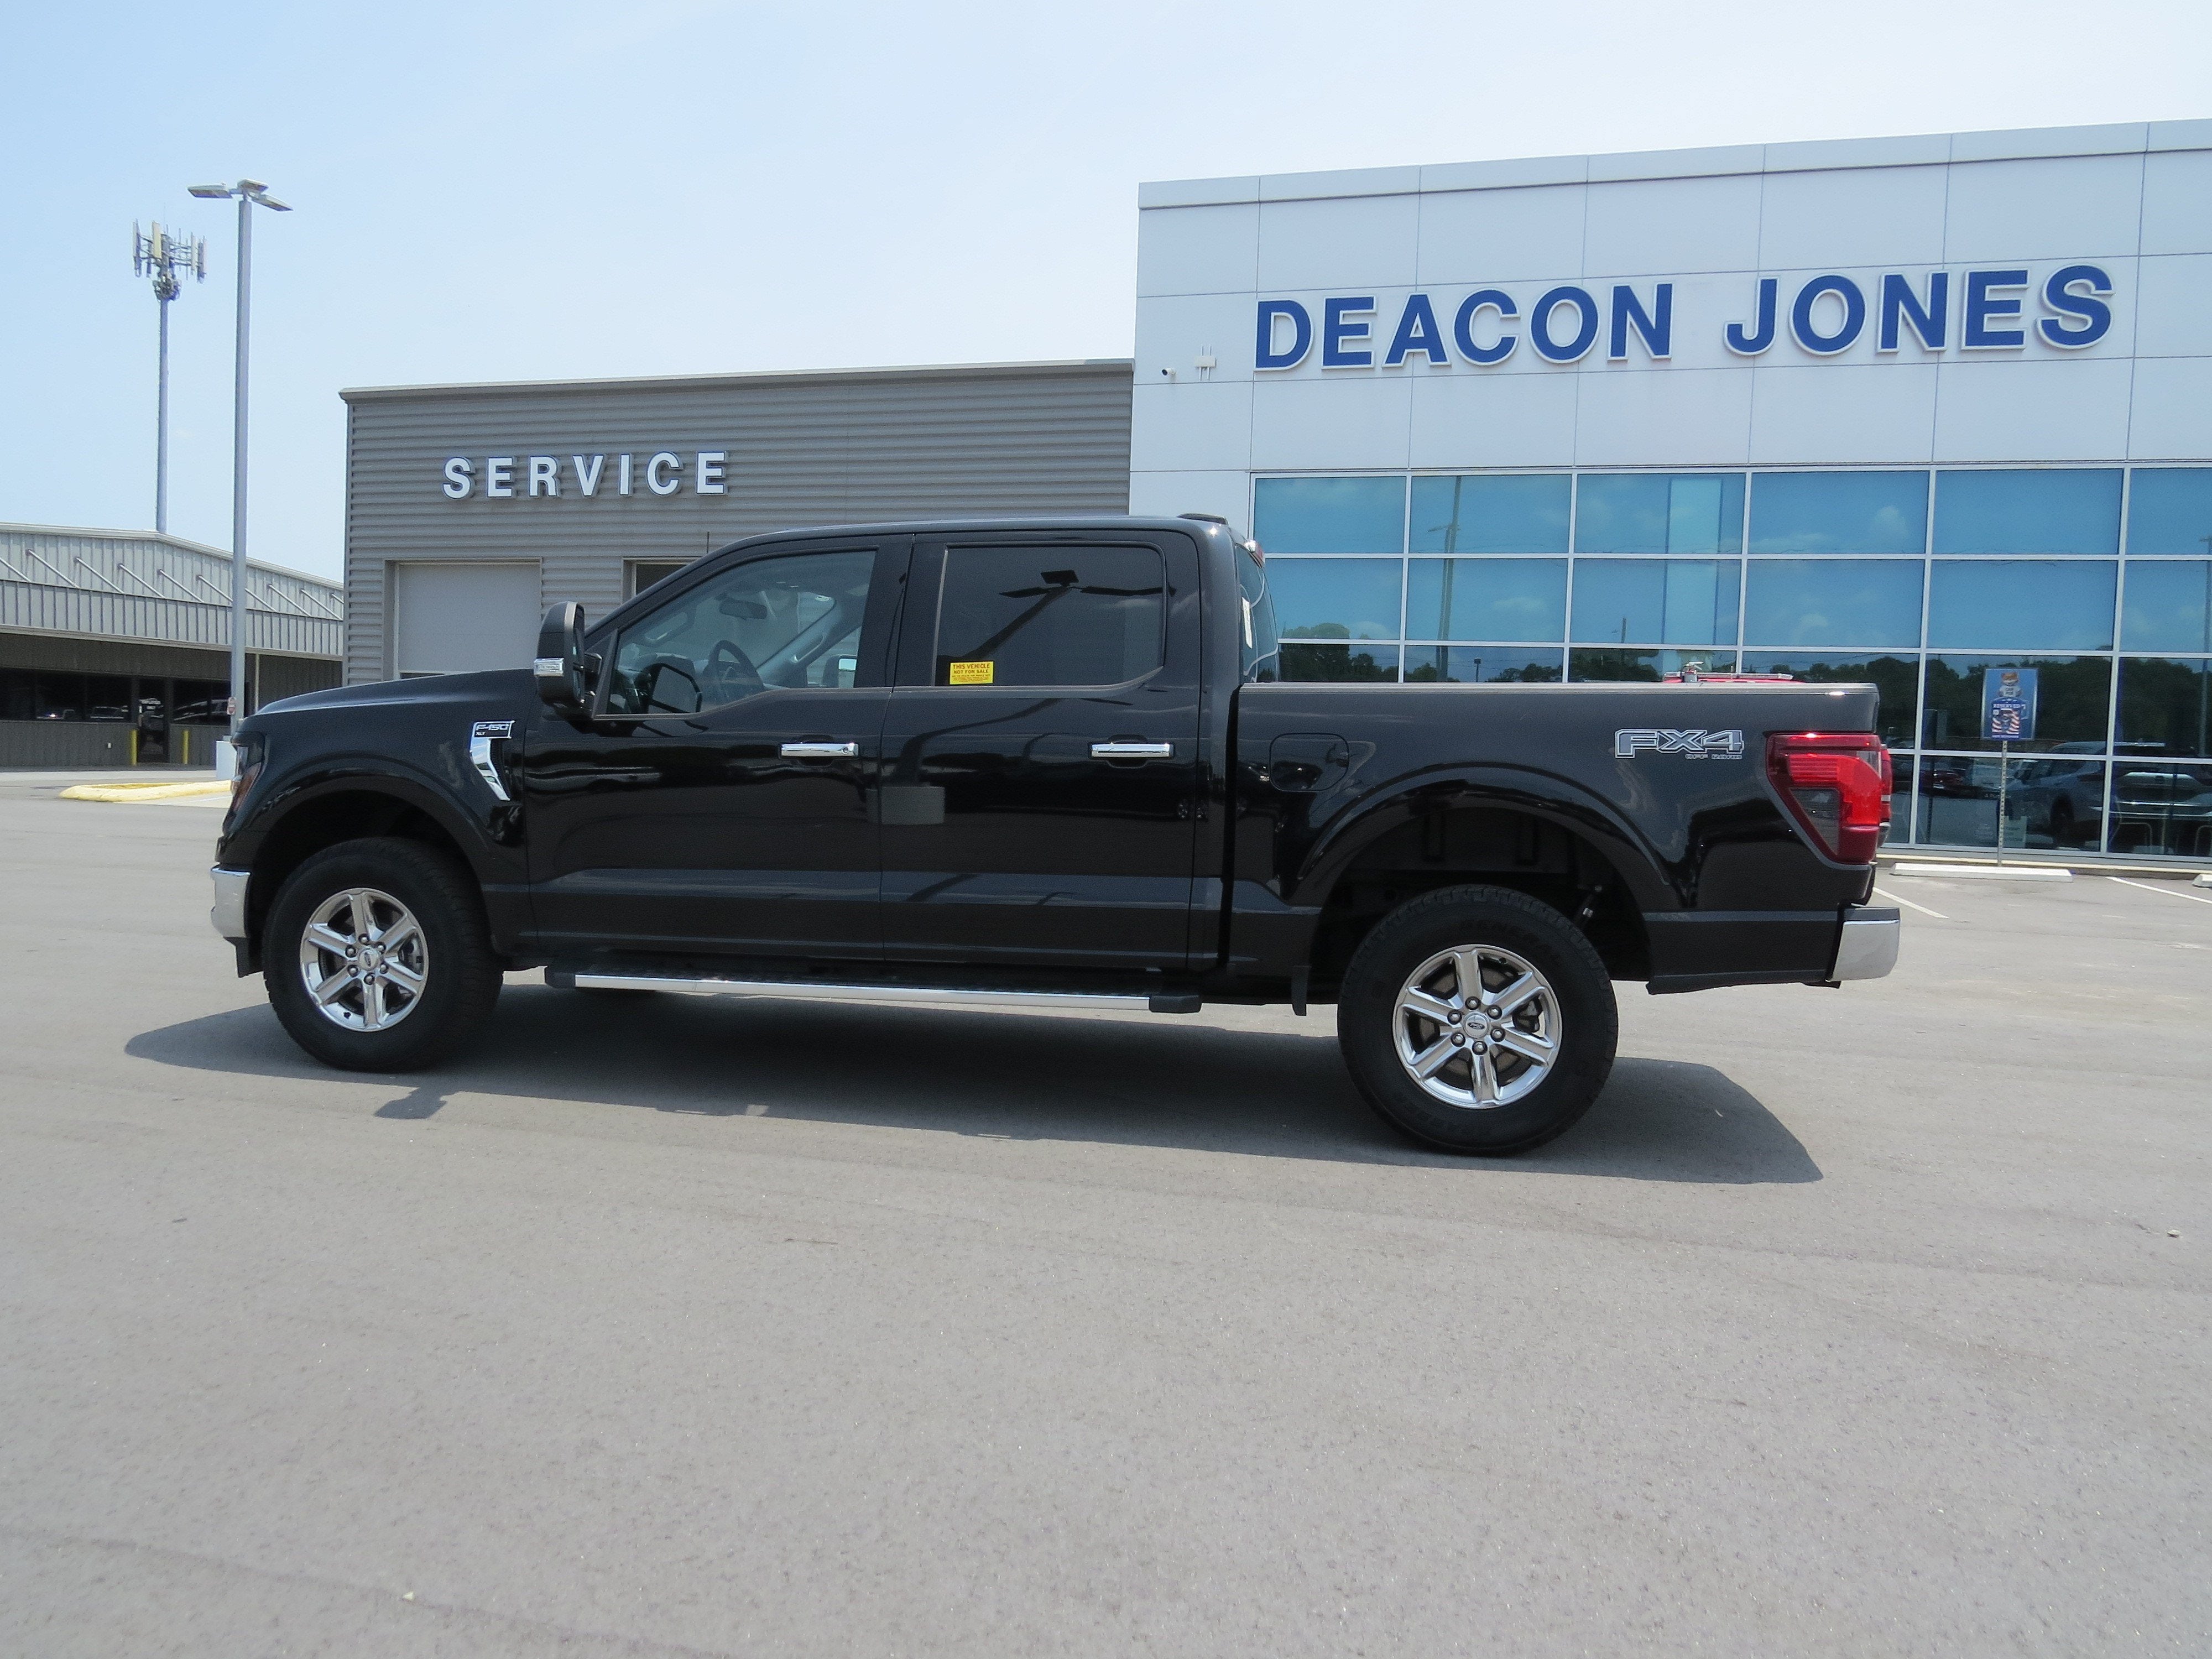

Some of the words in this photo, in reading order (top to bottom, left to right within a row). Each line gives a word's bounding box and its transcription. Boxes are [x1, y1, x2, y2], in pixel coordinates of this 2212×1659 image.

[1254, 282, 1673, 372] DEACON
[1723, 262, 2116, 357] JONES
[442, 451, 729, 499] SERVICE
[1615, 729, 1744, 759] FX4
